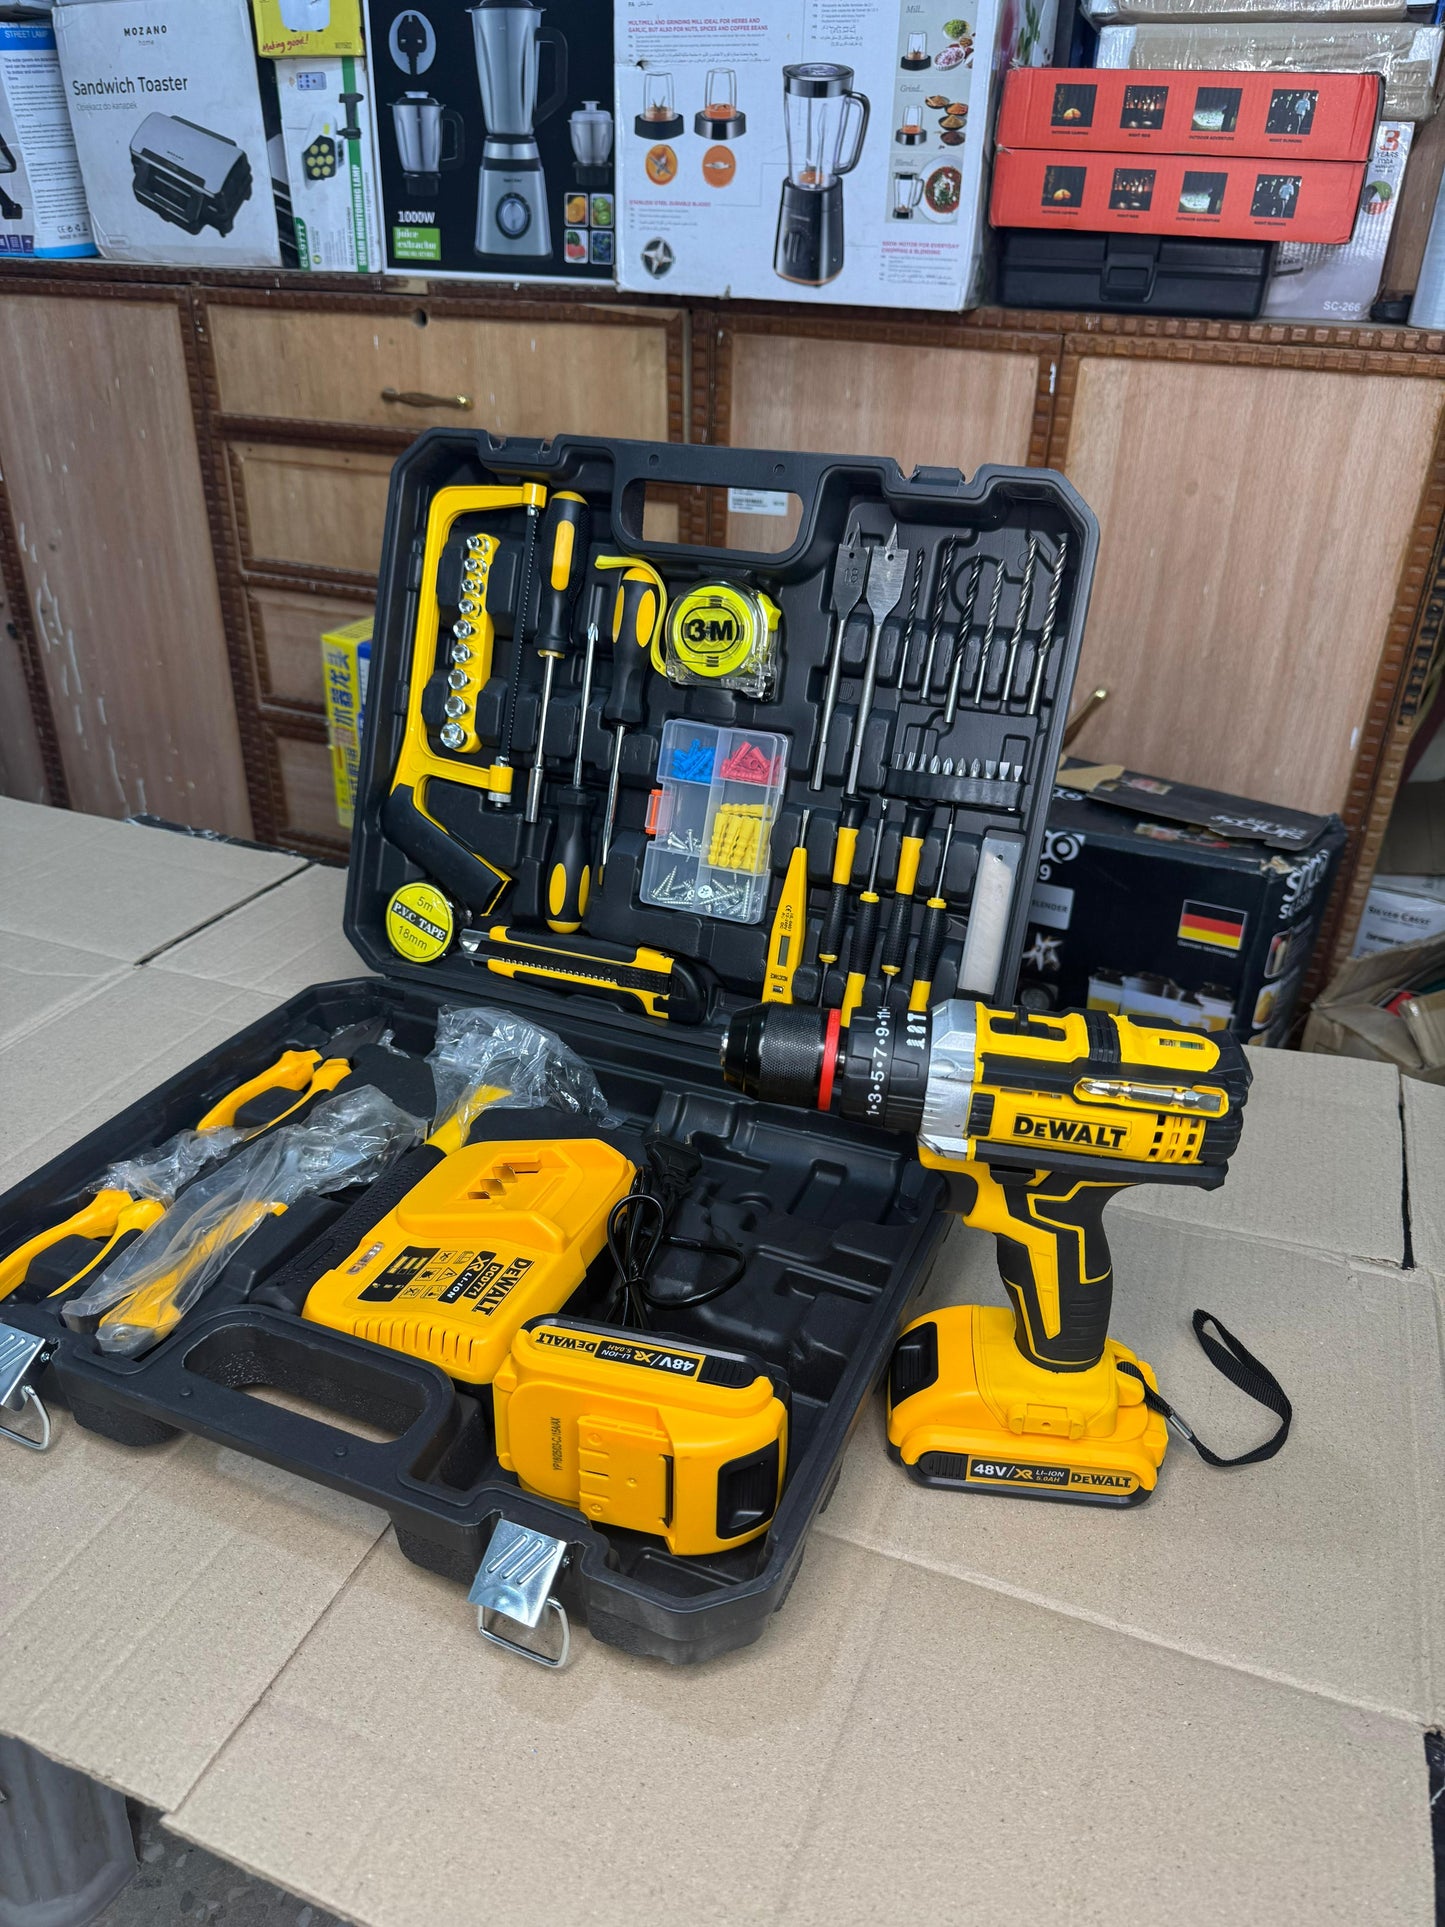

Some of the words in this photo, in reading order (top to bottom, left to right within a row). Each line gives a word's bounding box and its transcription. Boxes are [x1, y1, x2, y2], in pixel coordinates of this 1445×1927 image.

[123, 25, 168, 37] MOZANO
[72, 76, 135, 97] Sandwich
[137, 76, 188, 93] Toaster
[1379, 129, 1401, 151] 3
[397, 209, 436, 224] 1000W
[1322, 300, 1361, 312] SC-266
[416, 896, 434, 913] 5m
[398, 925, 428, 951] 18mm
[418, 917, 446, 941] TAPE
[1013, 1115, 1127, 1148] DEWALT
[447, 1272, 473, 1299] LI-ION
[467, 1264, 500, 1298] DCD771
[600, 1349, 631, 1360] LI-ION
[1036, 1469, 1065, 1478] LI-ION
